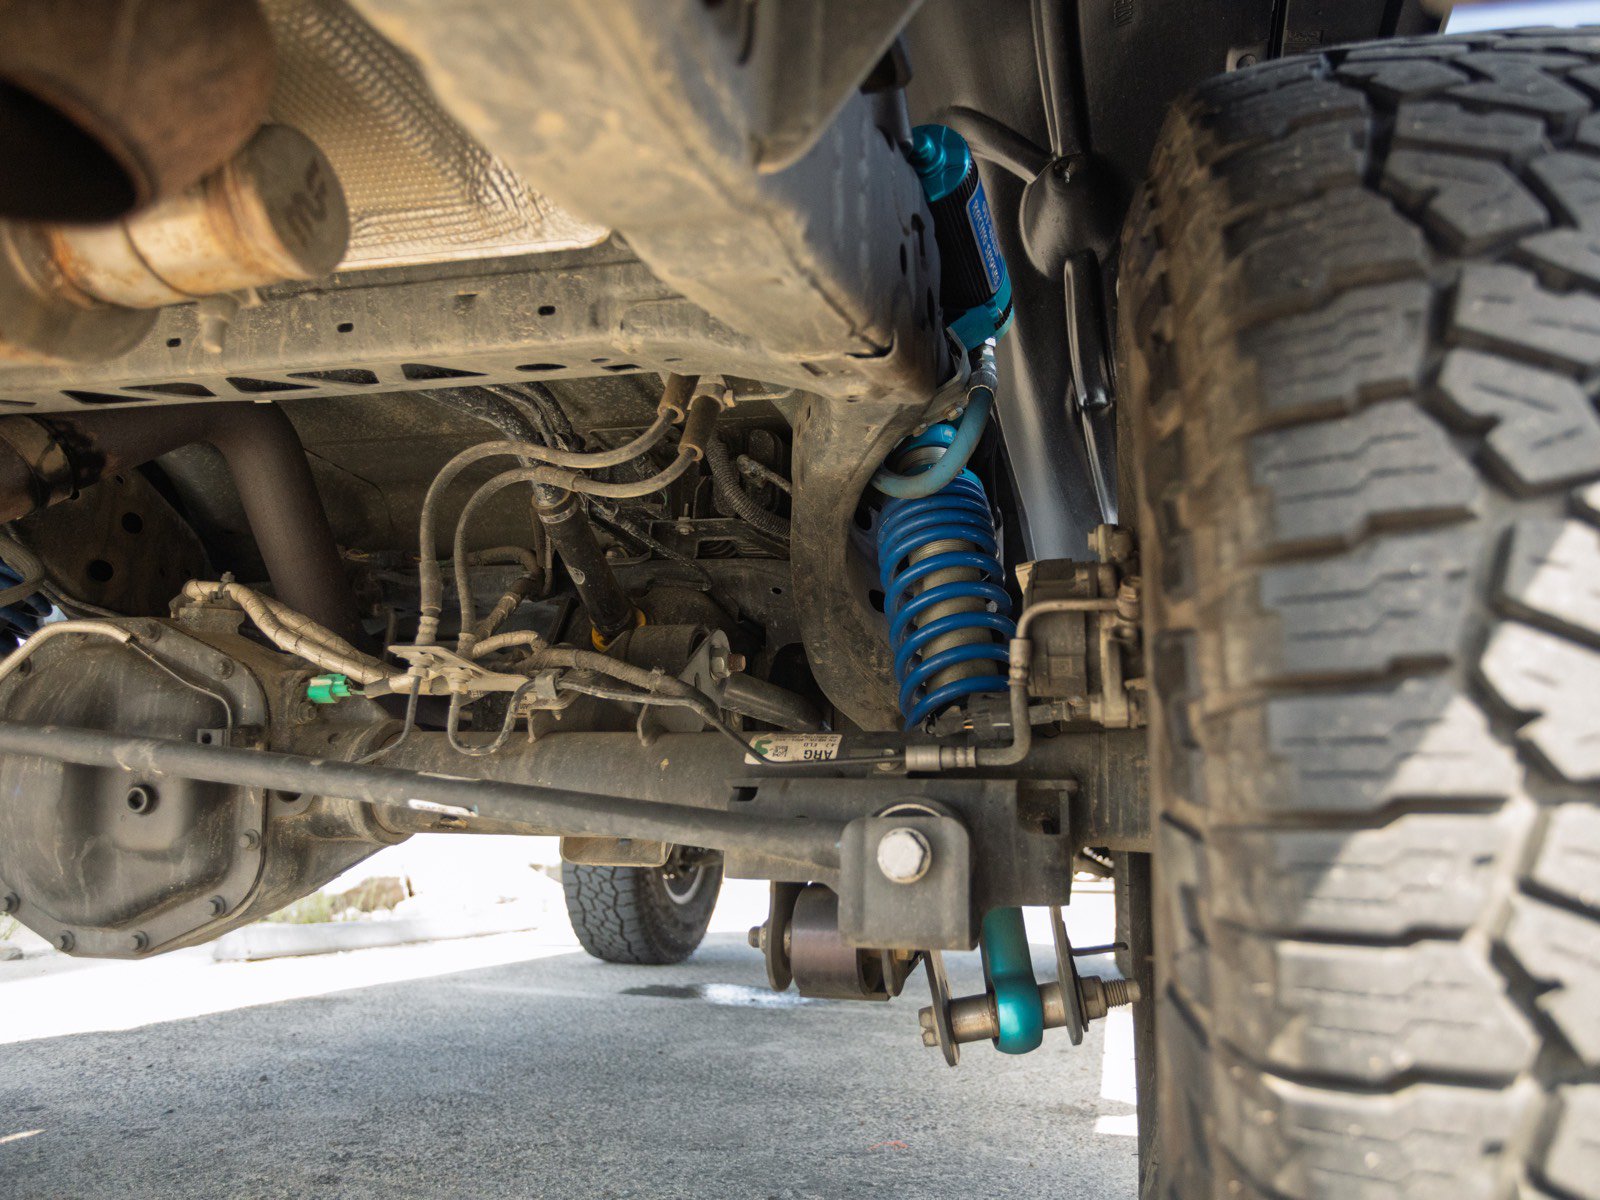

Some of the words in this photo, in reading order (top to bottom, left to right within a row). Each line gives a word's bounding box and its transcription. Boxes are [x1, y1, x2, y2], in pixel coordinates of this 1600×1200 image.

[972, 199, 988, 246] RACING
[985, 244, 1000, 286] SHOCKS
[804, 749, 833, 760] ARG
